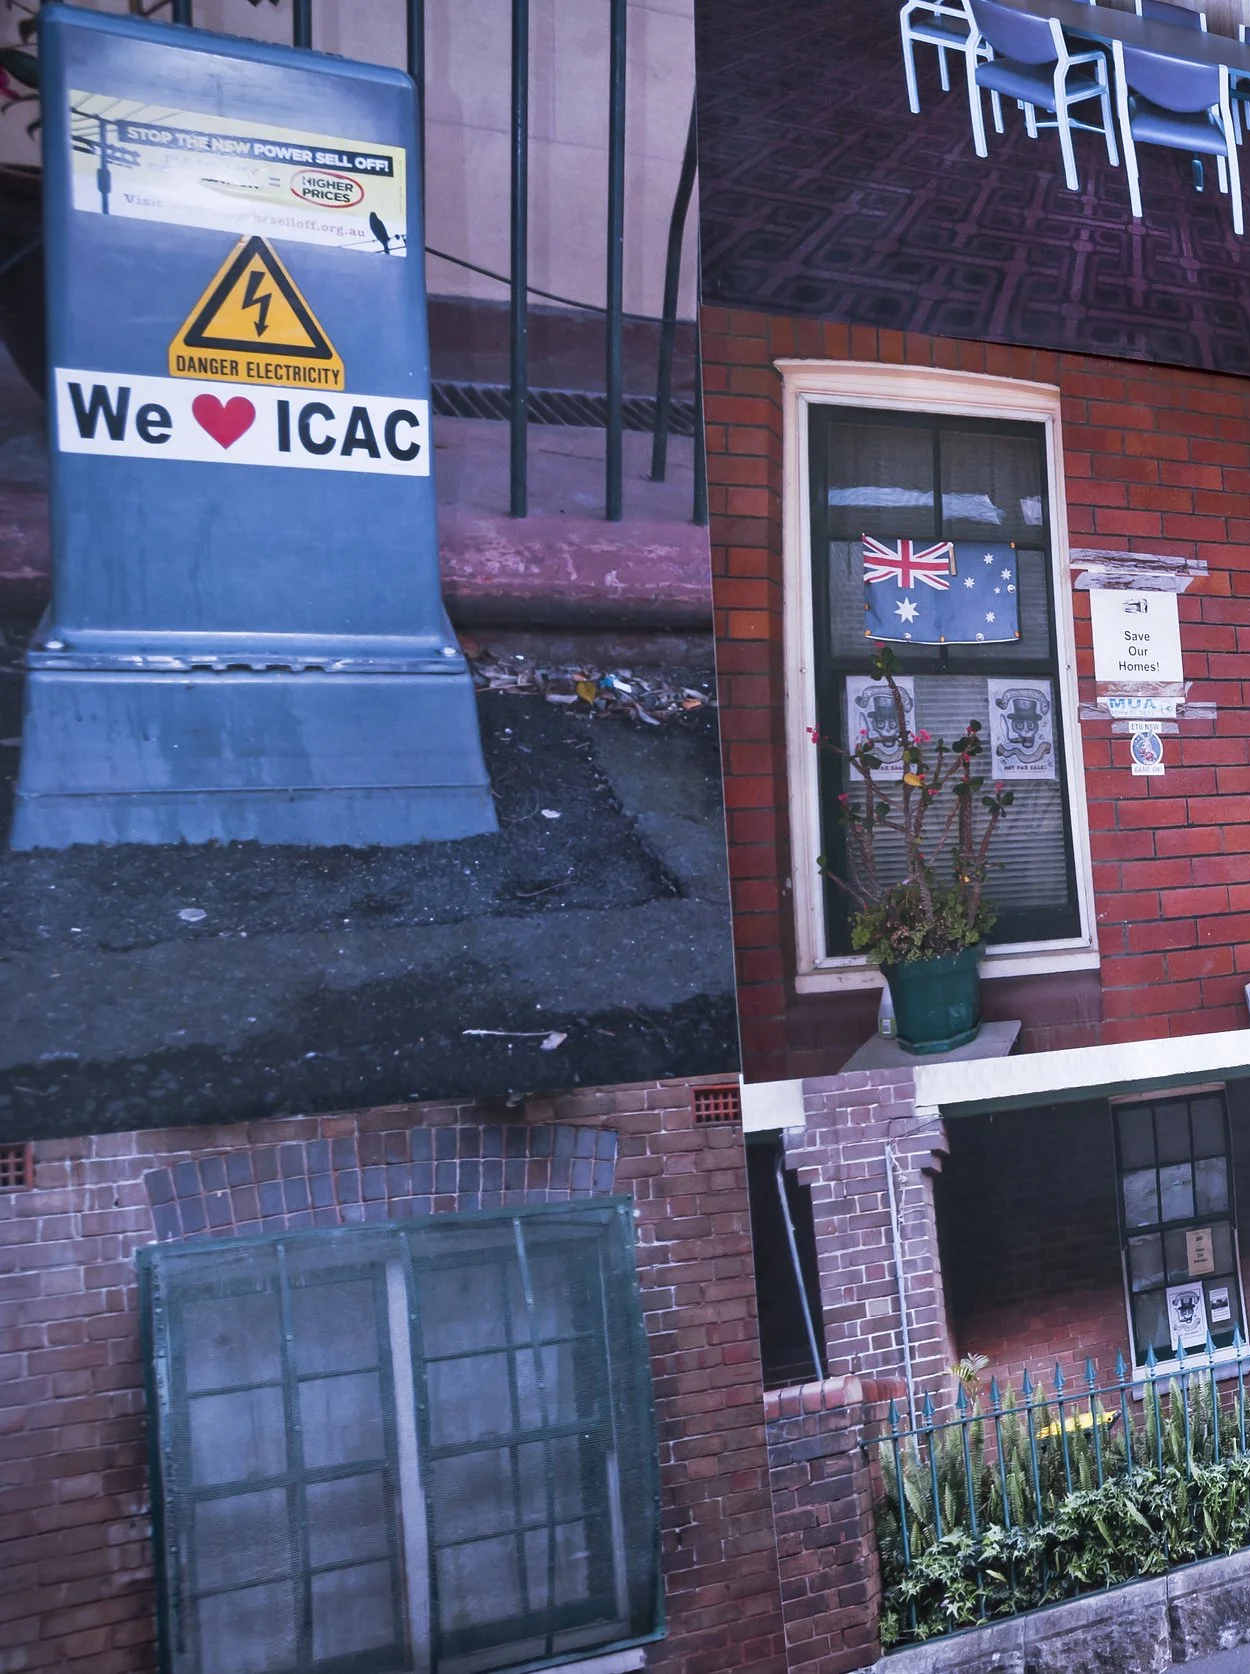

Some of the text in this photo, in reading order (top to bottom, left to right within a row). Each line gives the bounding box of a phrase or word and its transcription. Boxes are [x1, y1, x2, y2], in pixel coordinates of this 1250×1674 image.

[127, 126, 390, 172] STOP THE NEW POWER SELL OFF!
[302, 176, 354, 193] HIGHER
[123, 193, 164, 208] Visit
[302, 187, 351, 203] PRICES
[176, 355, 340, 386] DANGER ELECTRICITY
[67, 381, 421, 462] We ICAC
[1124, 630, 1151, 642] Save
[1128, 645, 1149, 657] Our
[1118, 660, 1160, 672] Homes!
[1108, 697, 1156, 710] MUA
[1131, 723, 1160, 731] ETU NSW
